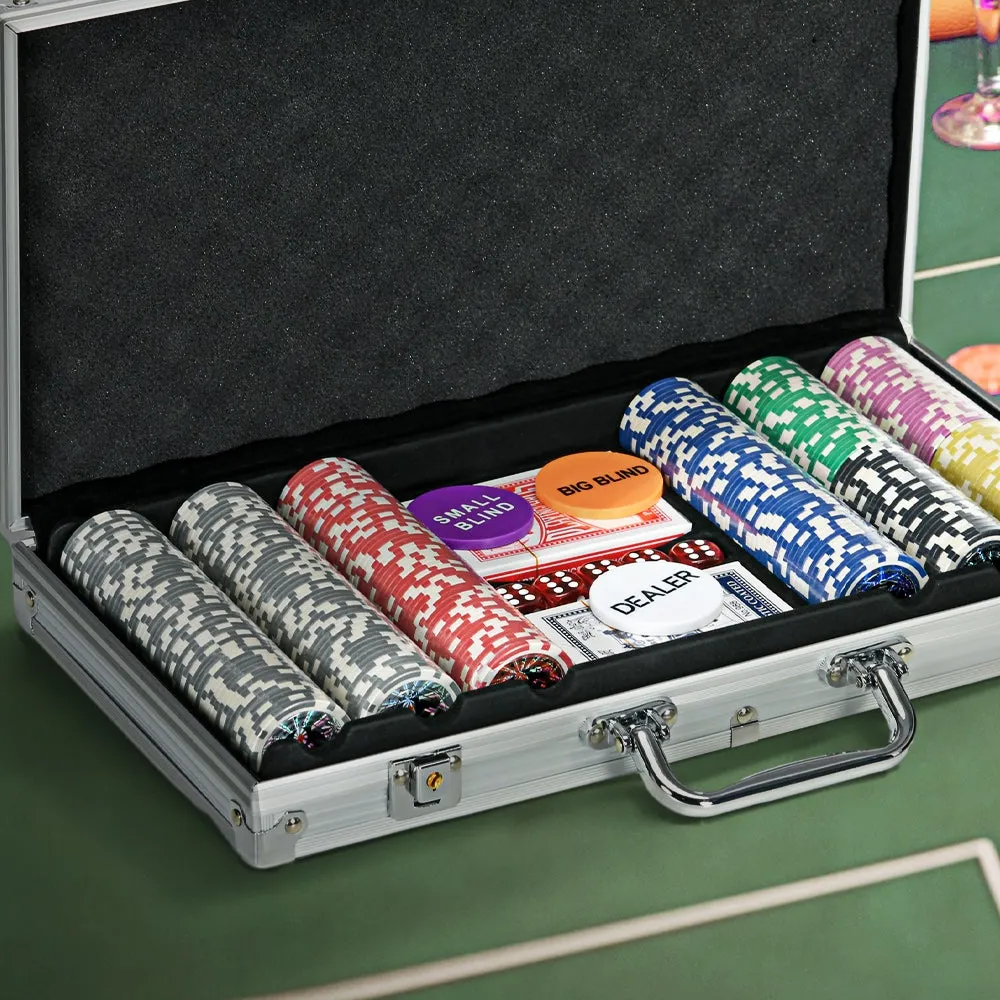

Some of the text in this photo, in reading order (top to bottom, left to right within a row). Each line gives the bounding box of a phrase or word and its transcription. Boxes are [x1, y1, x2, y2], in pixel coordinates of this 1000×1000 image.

[556, 480, 594, 497] BIG
[592, 465, 650, 486] BLIND
[433, 494, 501, 524] SMALL
[453, 502, 515, 531] BLIND
[610, 570, 700, 615] DEALER
[726, 580, 758, 605] COATED
